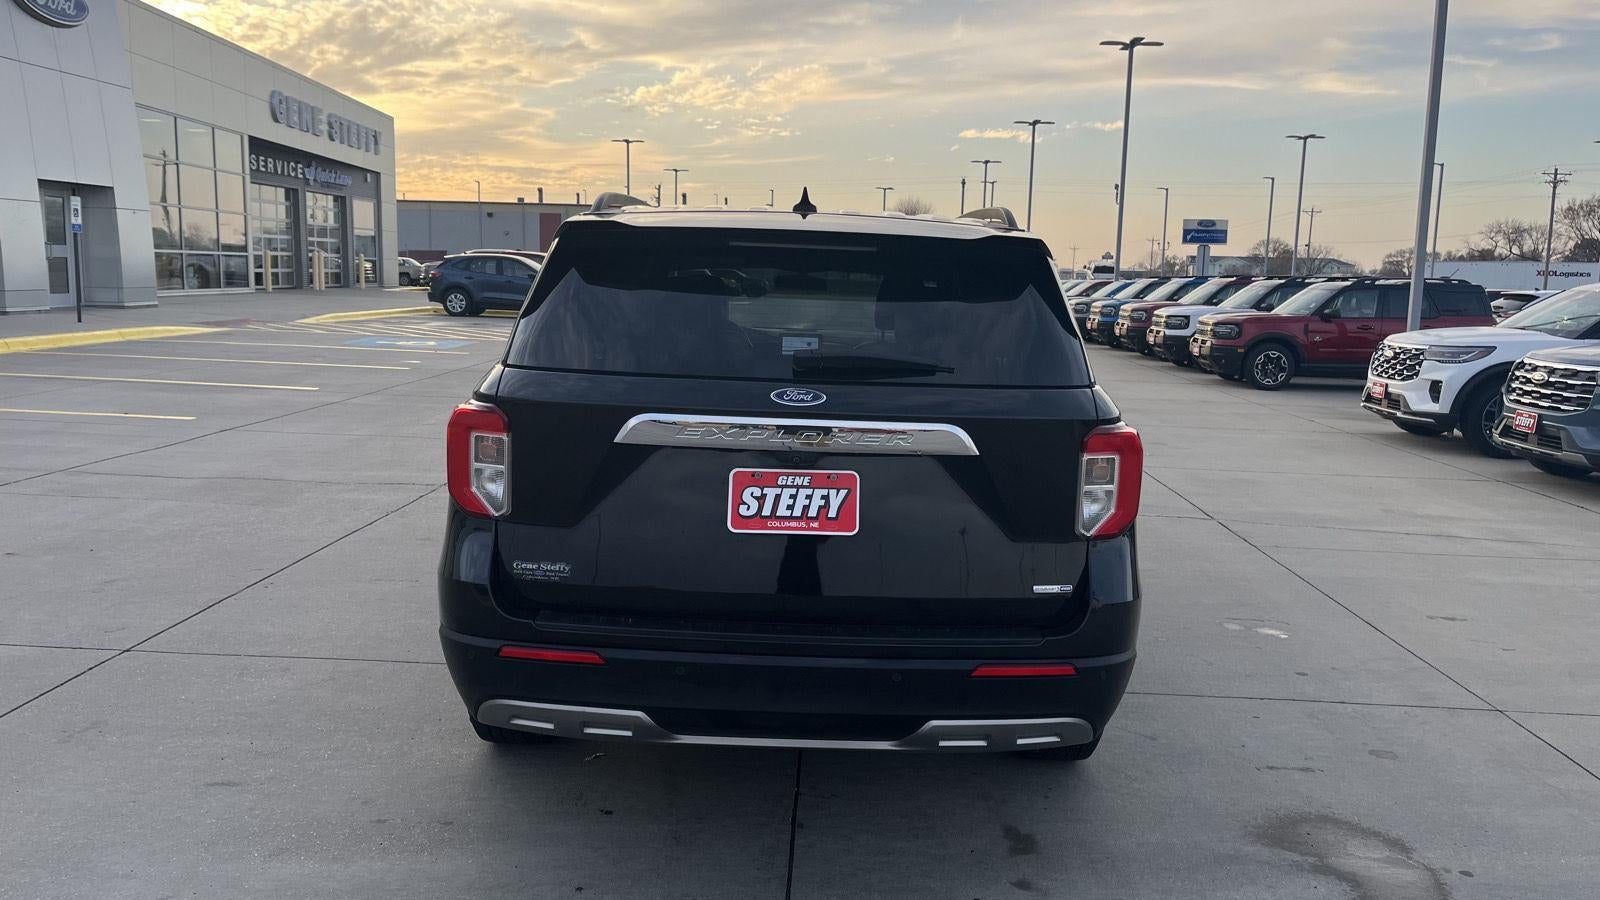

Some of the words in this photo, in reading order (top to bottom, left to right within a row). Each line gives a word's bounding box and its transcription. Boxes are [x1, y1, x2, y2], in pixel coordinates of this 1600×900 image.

[36, 0, 77, 15] ord
[270, 90, 323, 137] GENE
[327, 112, 381, 155] STEFFY
[249, 154, 303, 178] SERVICE
[783, 389, 814, 401] Ford
[676, 428, 913, 446] EXPLORER
[777, 475, 811, 486] GENE
[738, 486, 848, 518] STEFFY
[513, 561, 538, 570] Gene
[540, 563, 570, 573] Steffy
